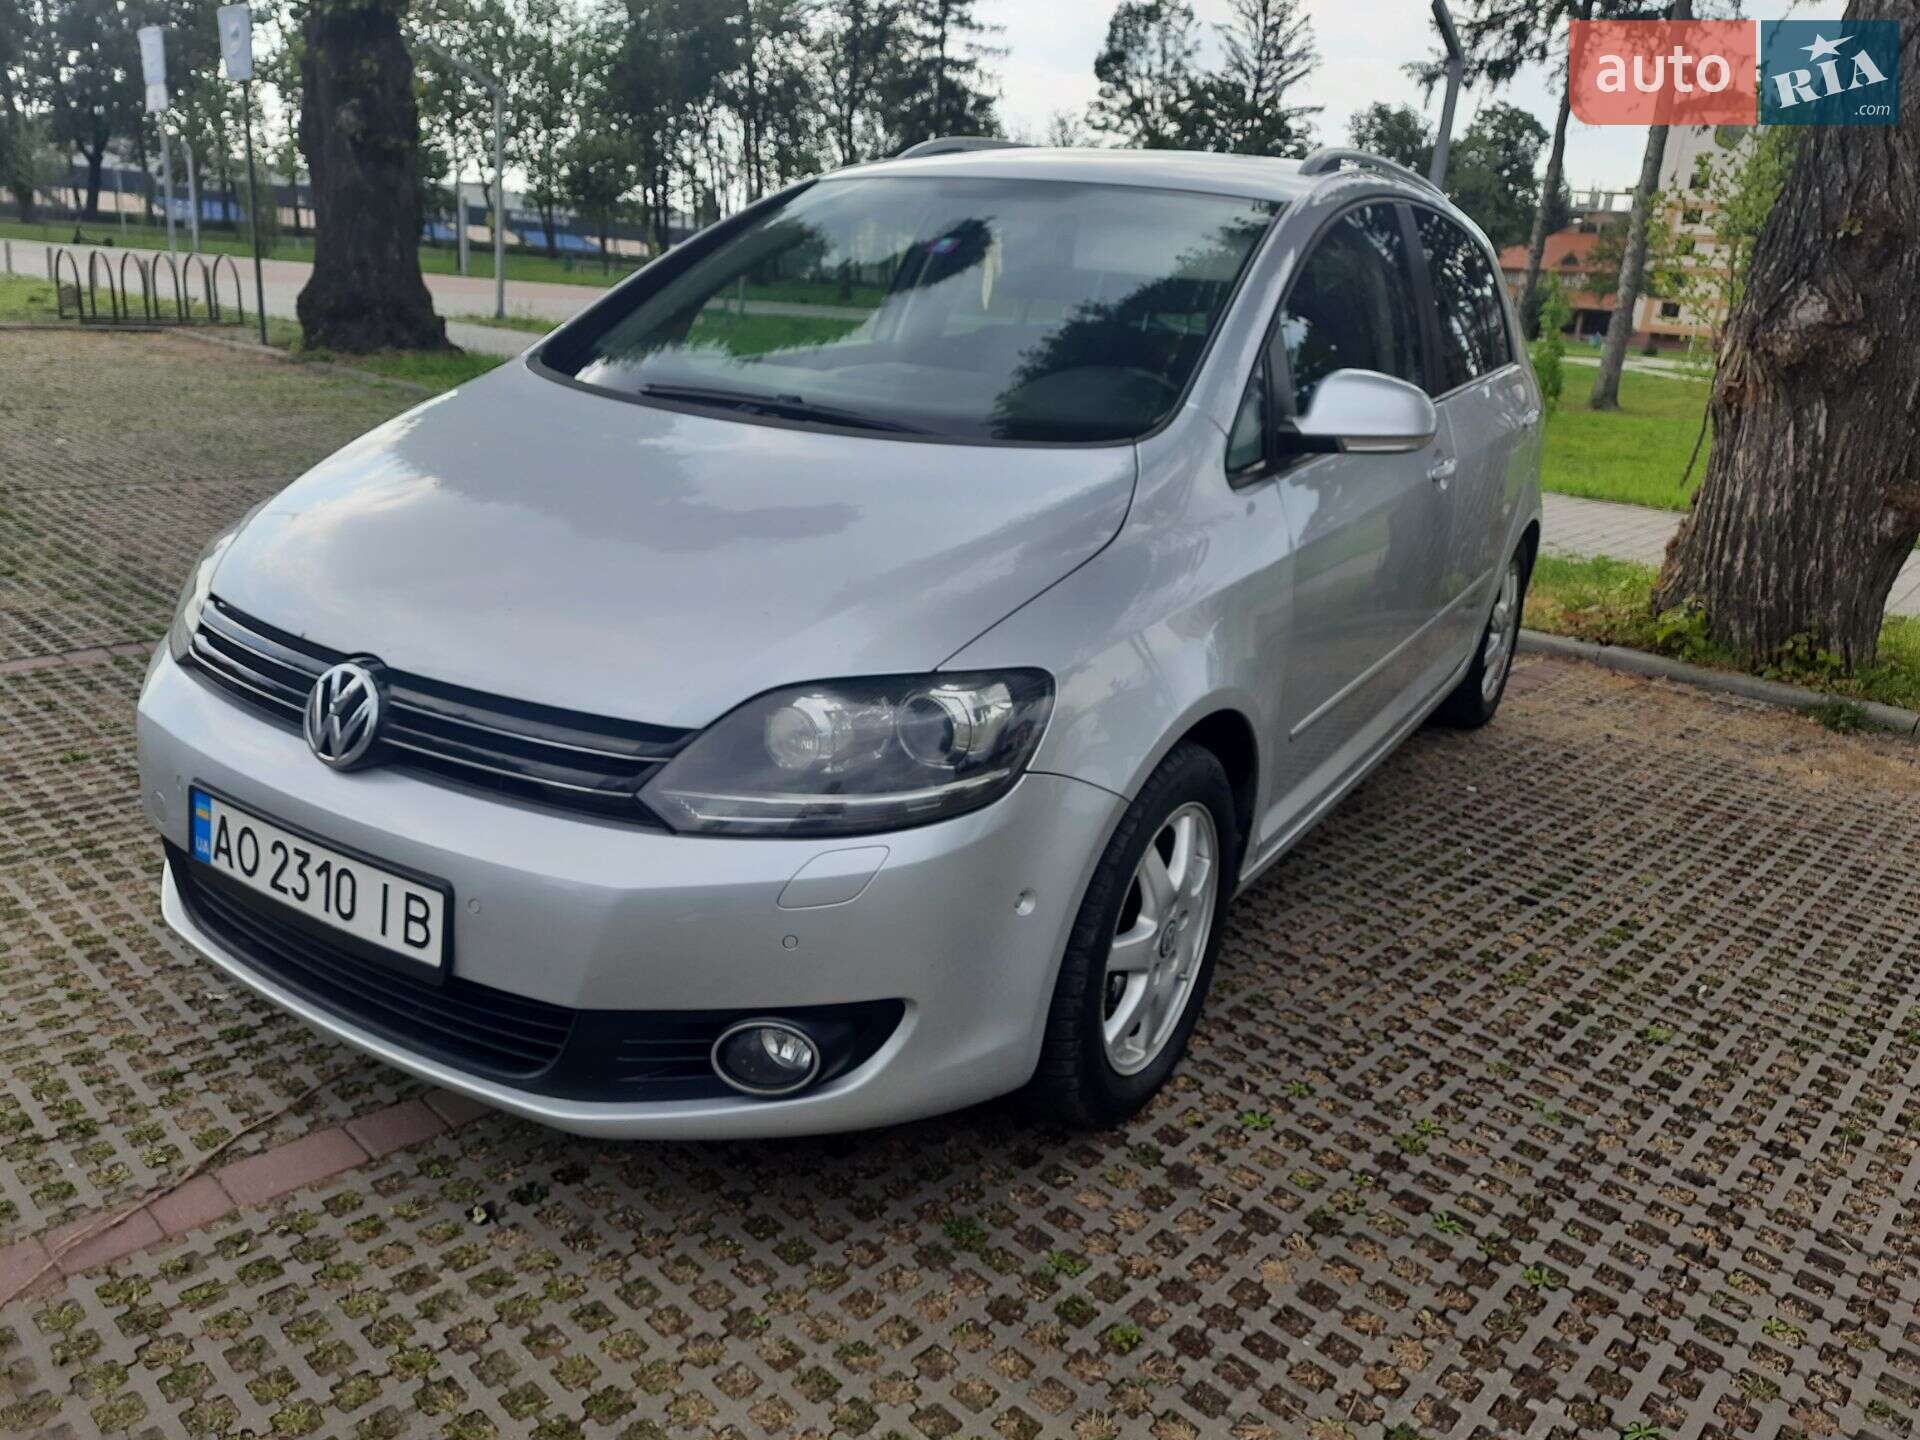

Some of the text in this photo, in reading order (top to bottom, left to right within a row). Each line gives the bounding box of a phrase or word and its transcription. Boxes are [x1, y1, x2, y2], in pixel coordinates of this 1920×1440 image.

[213, 814, 431, 949] AO 2310 IB
